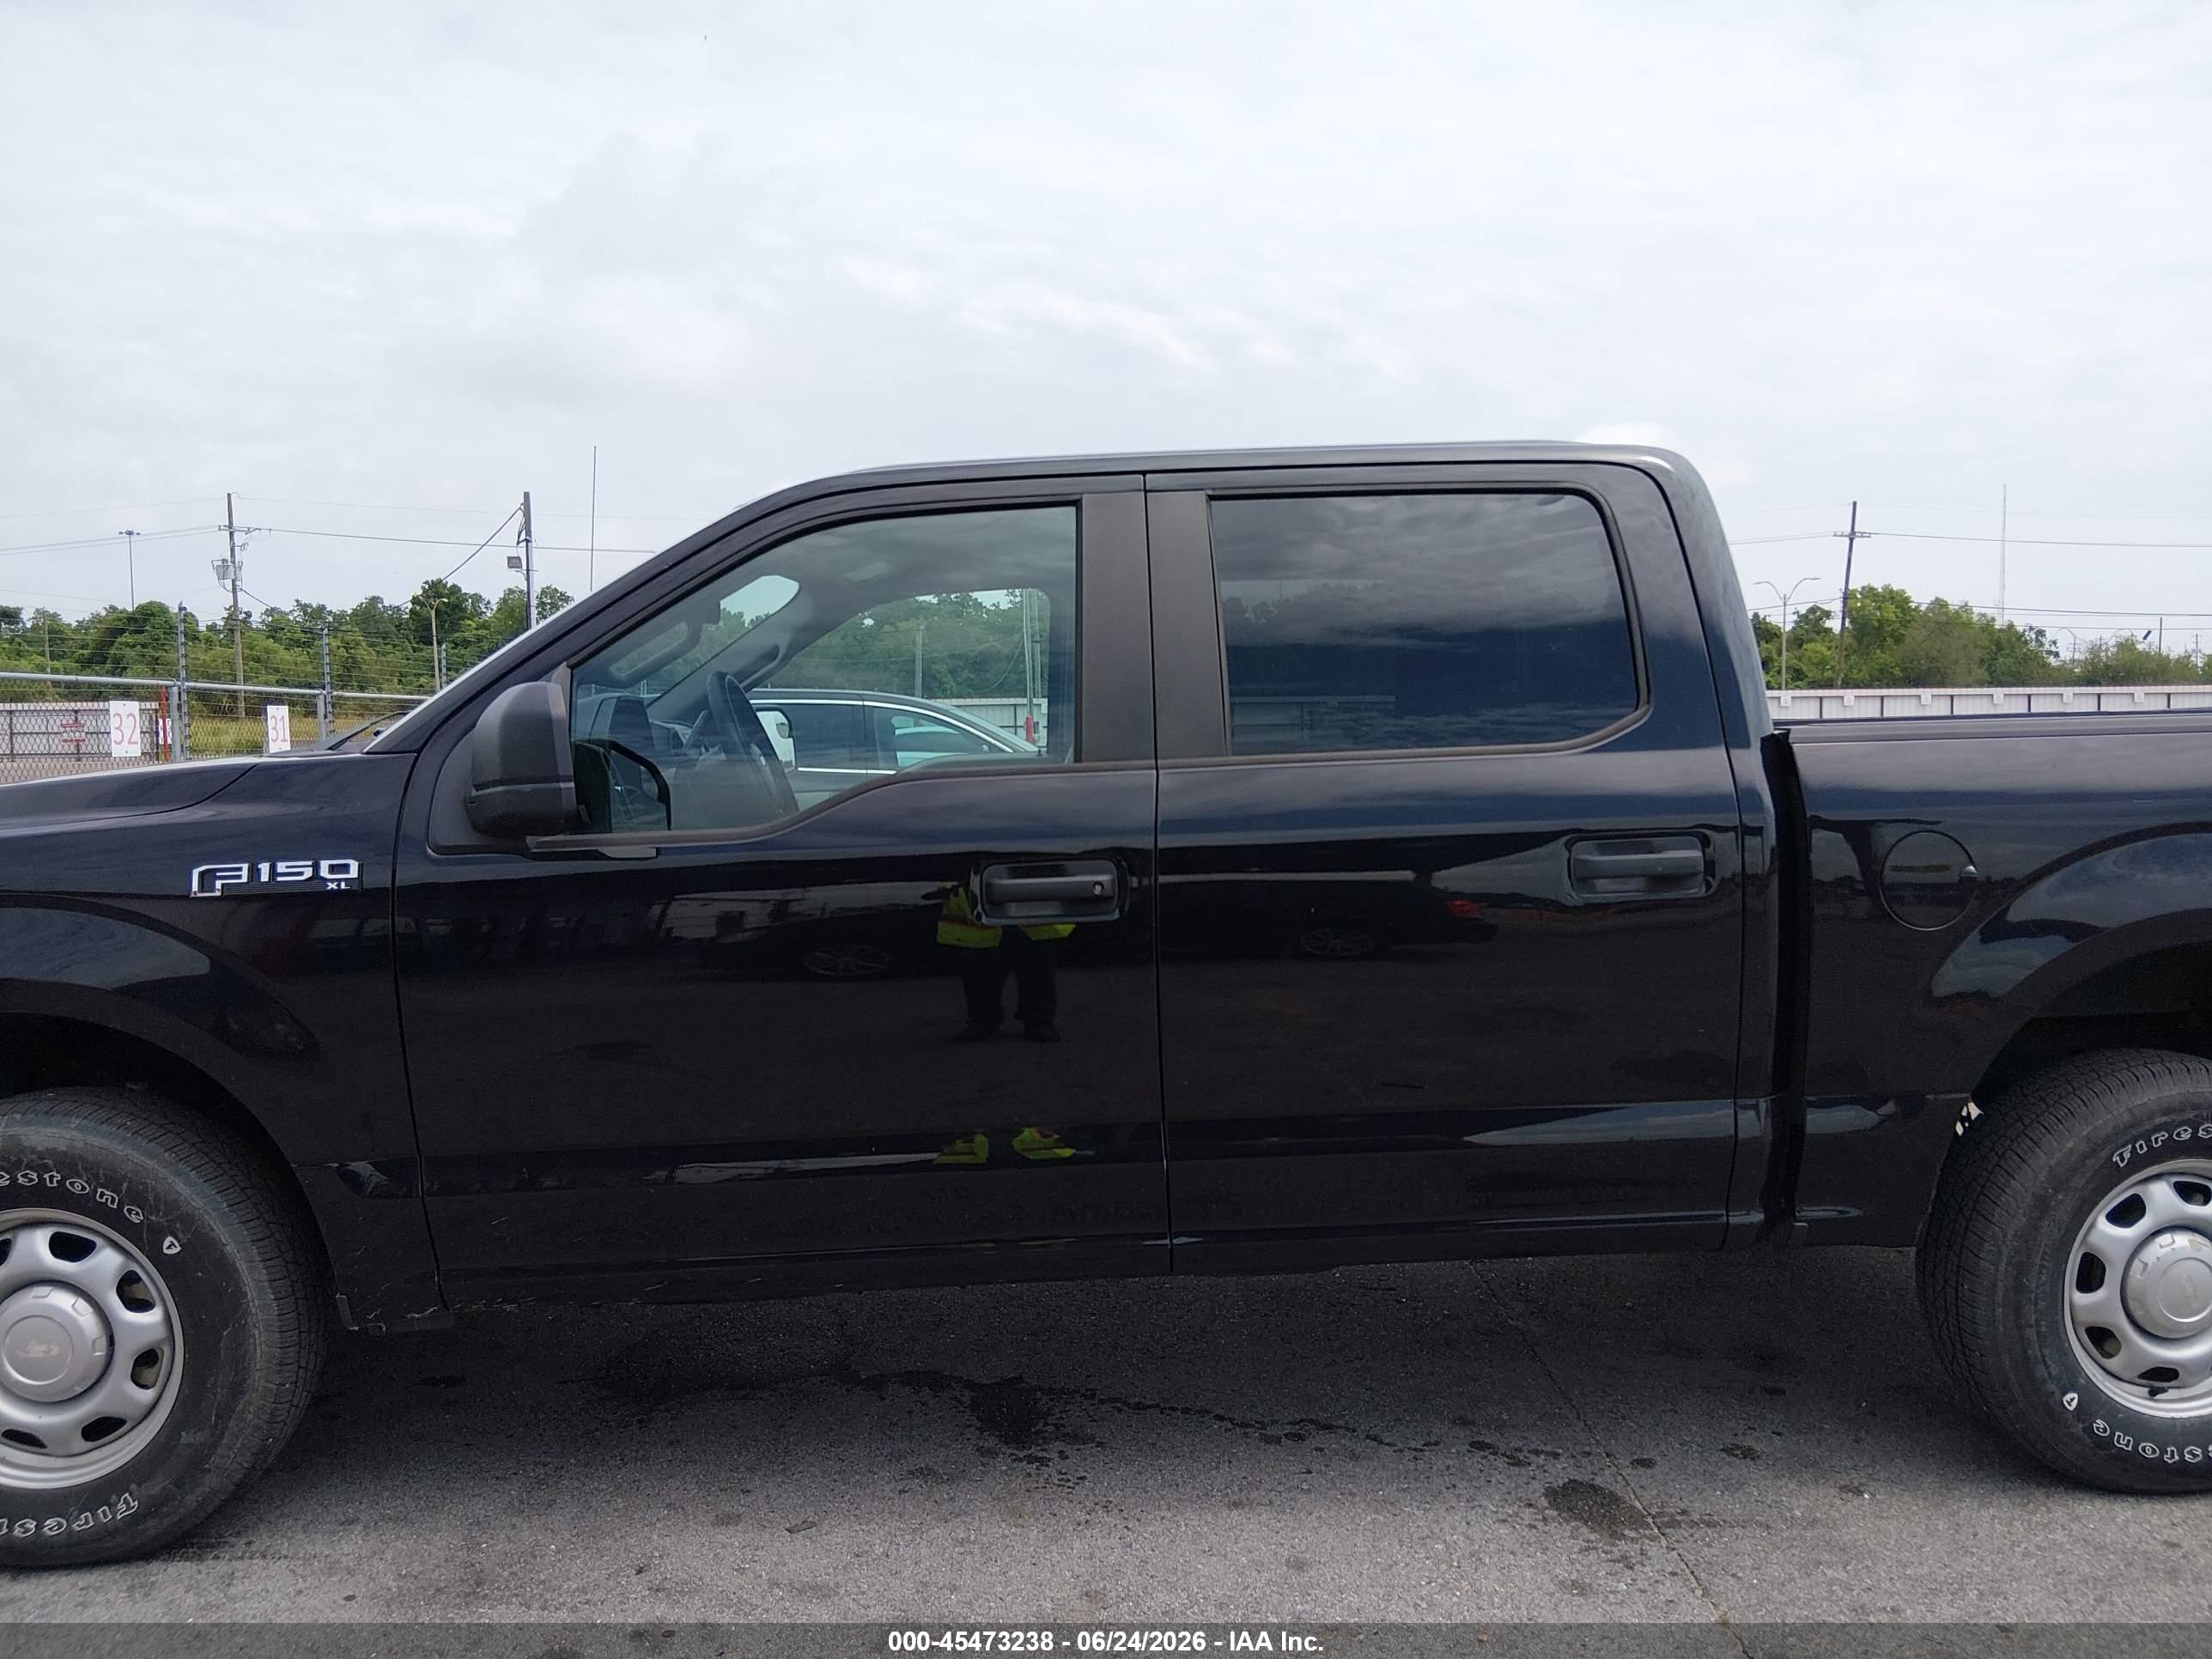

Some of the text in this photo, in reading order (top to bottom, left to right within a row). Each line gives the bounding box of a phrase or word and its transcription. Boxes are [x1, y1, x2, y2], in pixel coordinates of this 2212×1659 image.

[112, 712, 138, 745] 32
[270, 714, 289, 743] 31
[325, 881, 351, 890] XL
[2092, 1419, 2212, 1463] stone
